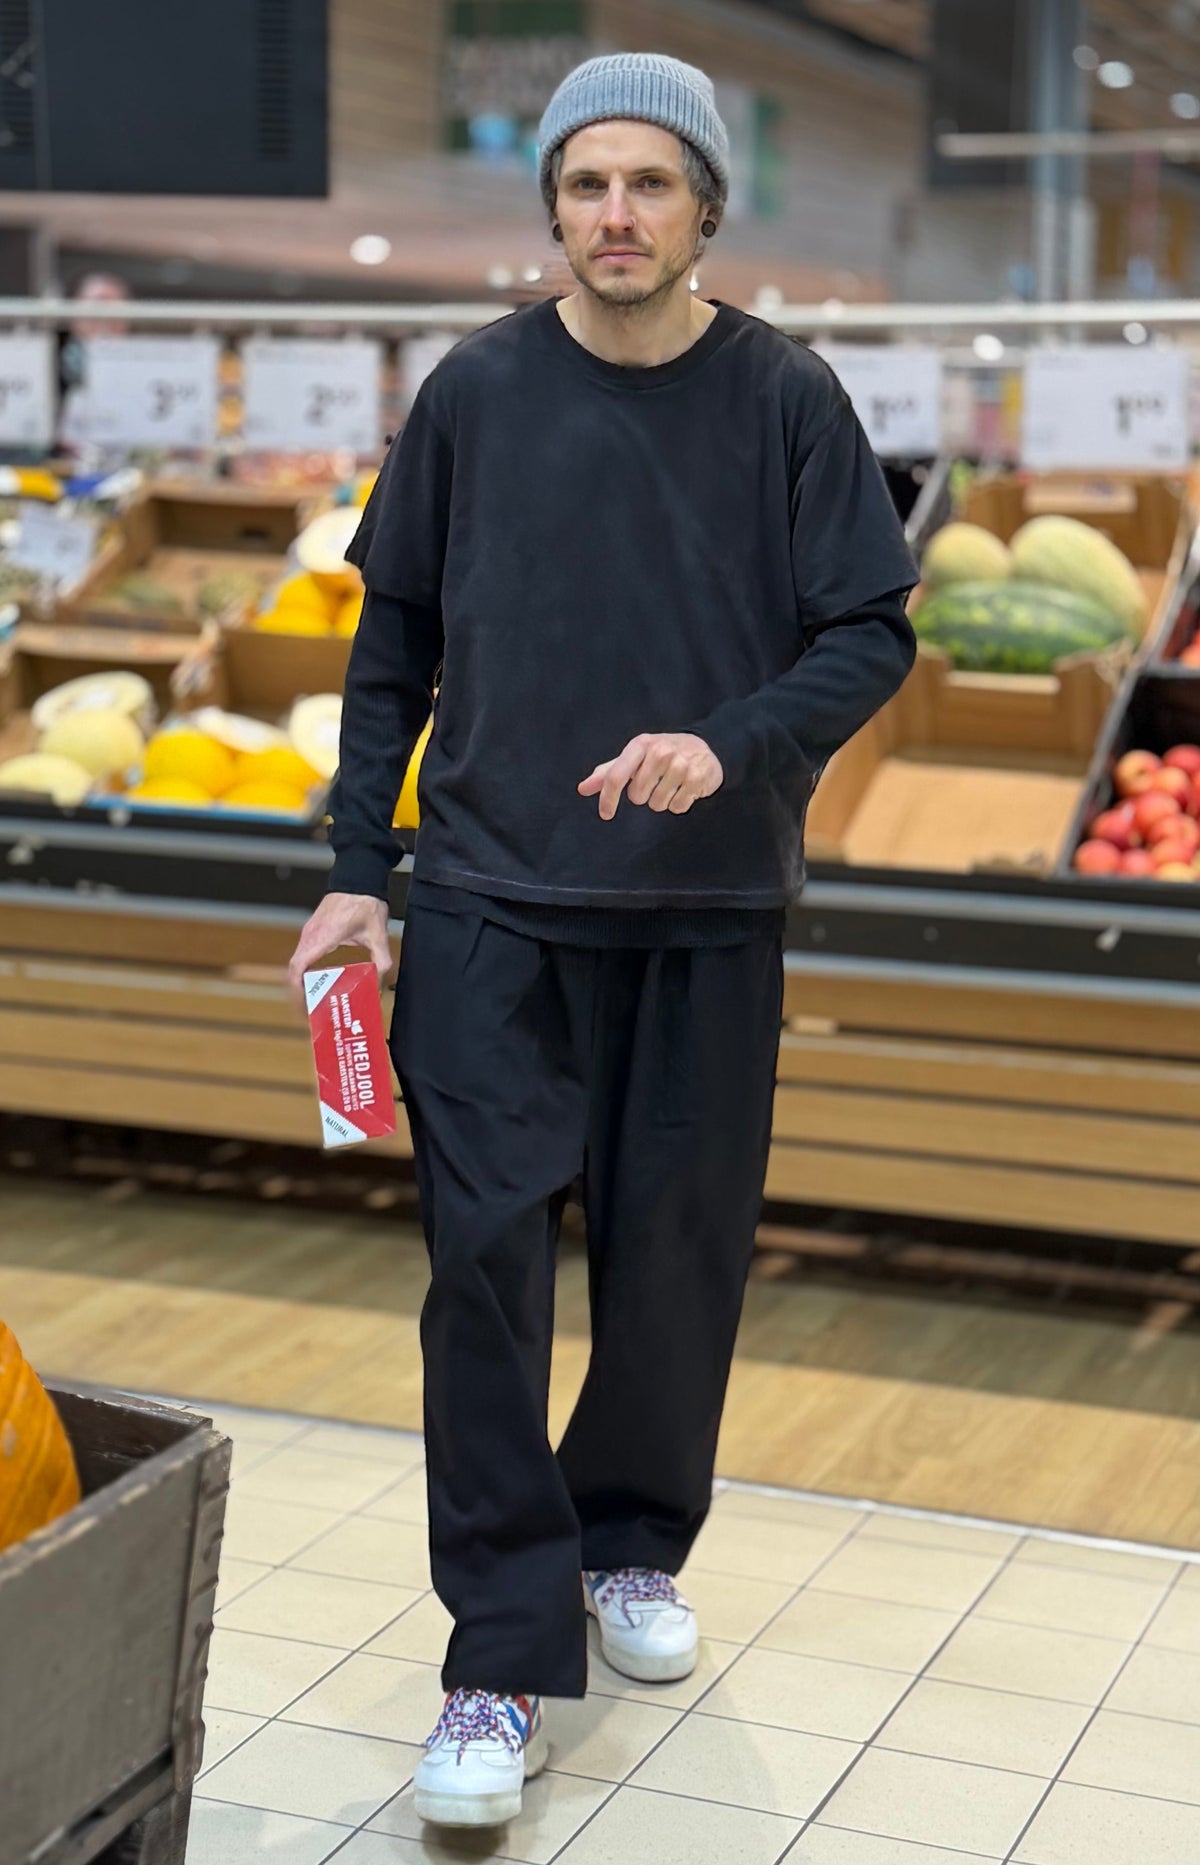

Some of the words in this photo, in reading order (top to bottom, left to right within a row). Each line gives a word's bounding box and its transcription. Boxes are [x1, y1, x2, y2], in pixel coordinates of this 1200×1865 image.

[308, 973, 329, 996] NATURAL
[340, 993, 352, 1028] KARSTEN
[352, 1041, 376, 1110] MEDJOOL
[325, 1115, 349, 1138] NATURAL
